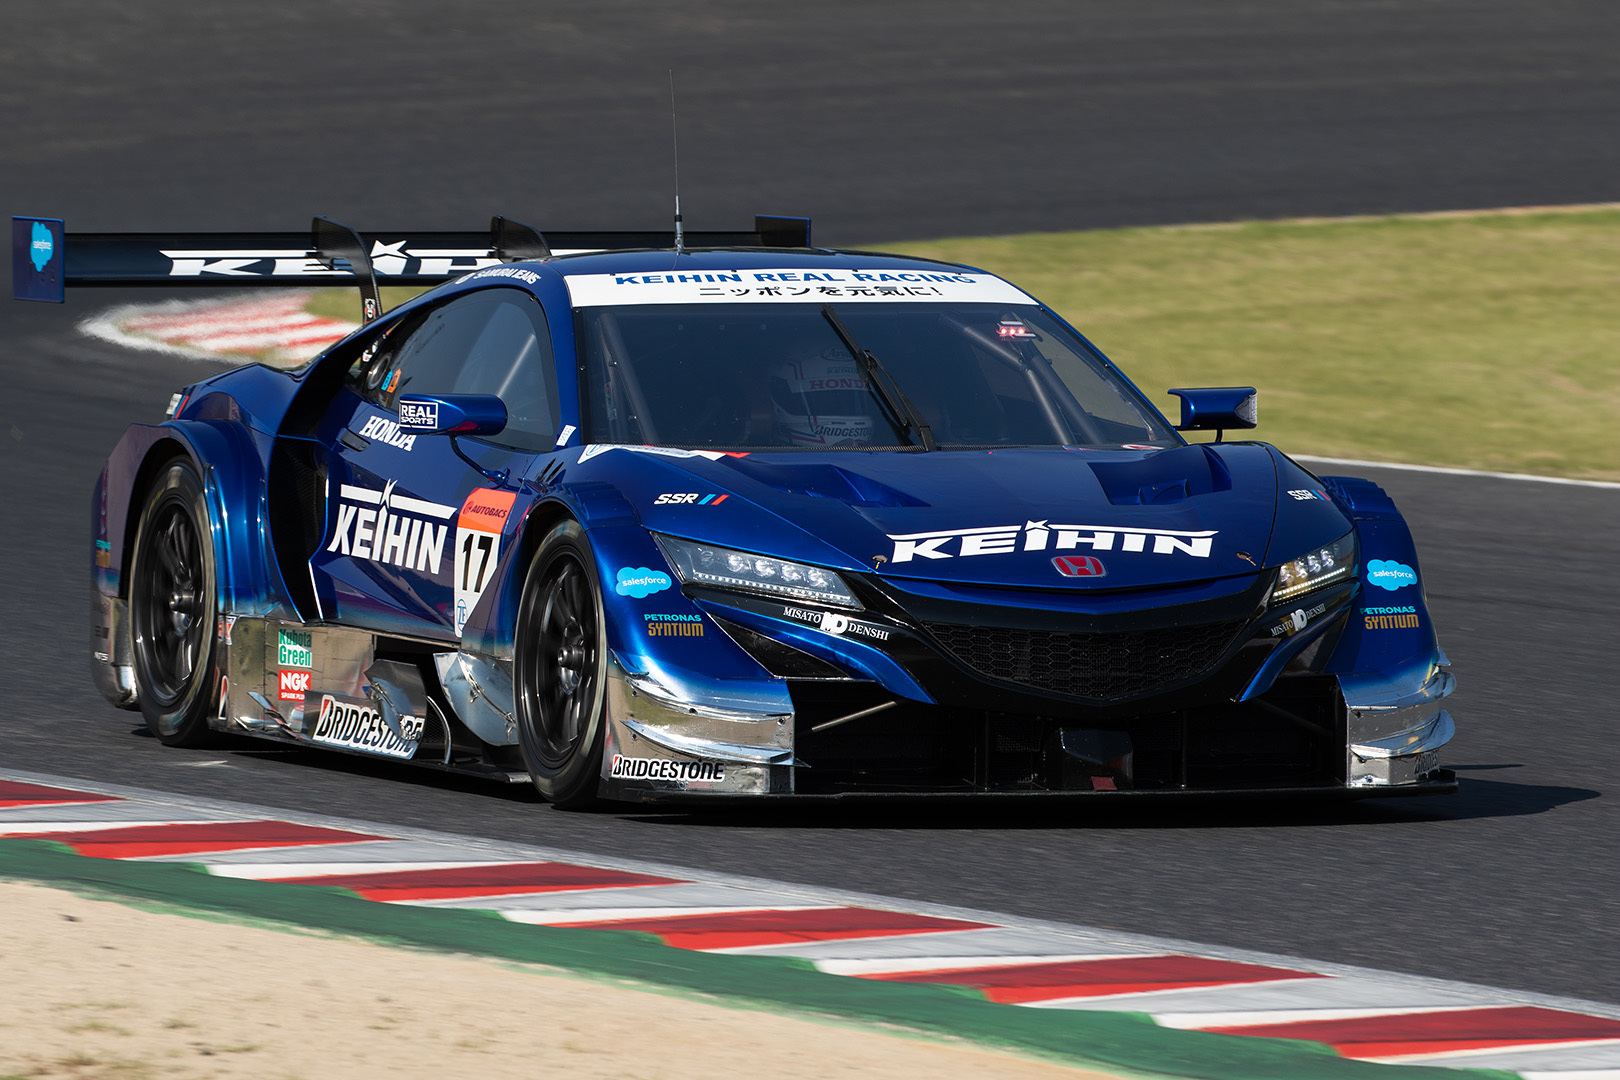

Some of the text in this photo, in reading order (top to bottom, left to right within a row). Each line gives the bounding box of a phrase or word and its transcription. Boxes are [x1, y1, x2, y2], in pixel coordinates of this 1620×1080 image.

[615, 272, 977, 285] KEIHIN REAL RACING
[401, 405, 437, 418] REAL
[401, 416, 434, 425] SPORTS
[654, 493, 699, 505] SSR
[1287, 489, 1317, 501] SSR
[472, 504, 508, 519] AUTOBACS
[327, 499, 449, 575] KEIHIN
[888, 522, 1216, 563] KEIHIN
[462, 533, 494, 594] 17
[621, 576, 667, 587] salesforce
[1372, 569, 1414, 579] salesforce
[644, 613, 702, 622] PETRONAS
[1360, 605, 1416, 615] PETRONAS
[648, 622, 704, 637] SYNTIUM
[783, 606, 821, 623] MISATO
[848, 623, 889, 640] DENSHI
[1365, 614, 1420, 630] SYNTIUM
[279, 628, 312, 647] Kubota
[279, 645, 311, 667] Green
[281, 672, 310, 692] NGK
[612, 756, 725, 780] BRIDGESTONE
